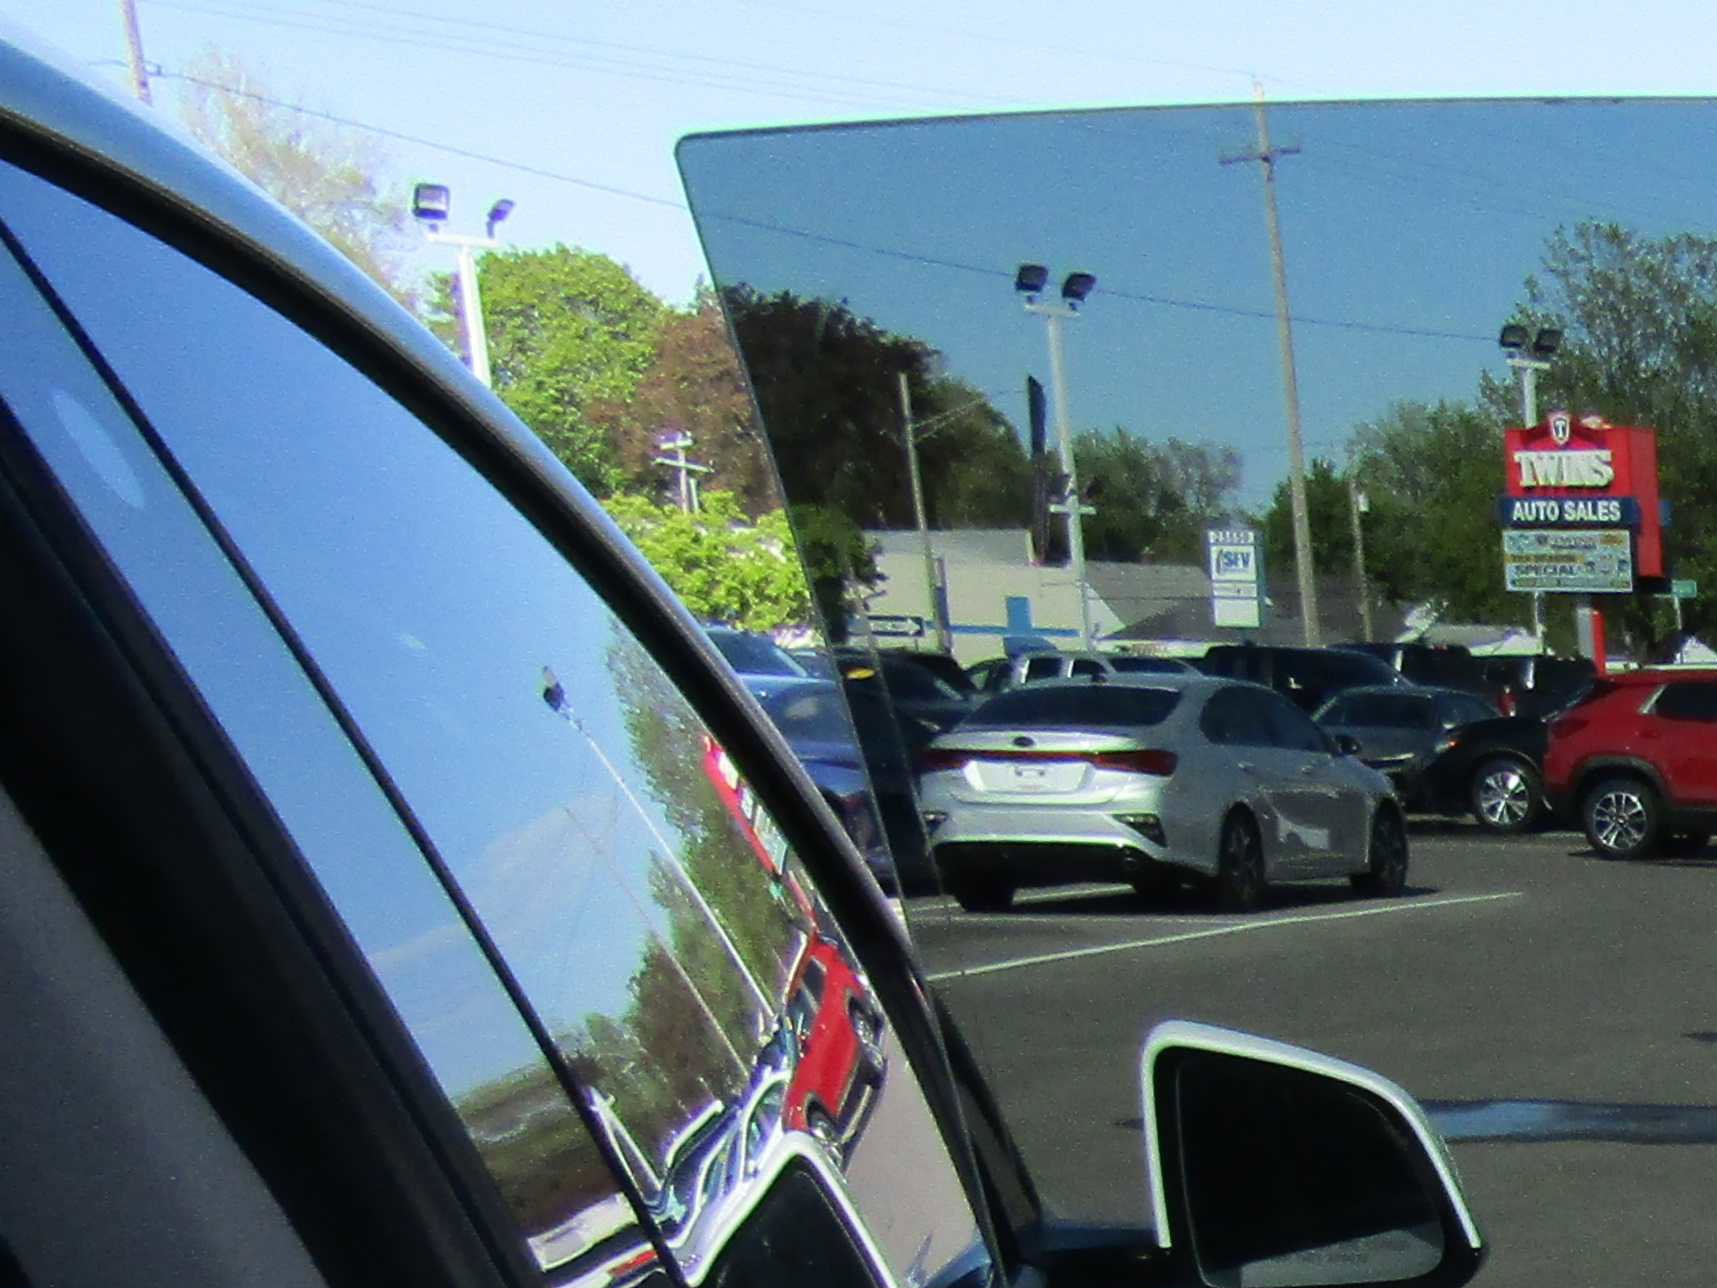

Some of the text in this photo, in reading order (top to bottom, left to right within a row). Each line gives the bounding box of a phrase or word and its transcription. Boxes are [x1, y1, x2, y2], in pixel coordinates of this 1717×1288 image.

[1513, 449, 1615, 487] TWINS
[1512, 500, 1621, 522] AUTO SALES
